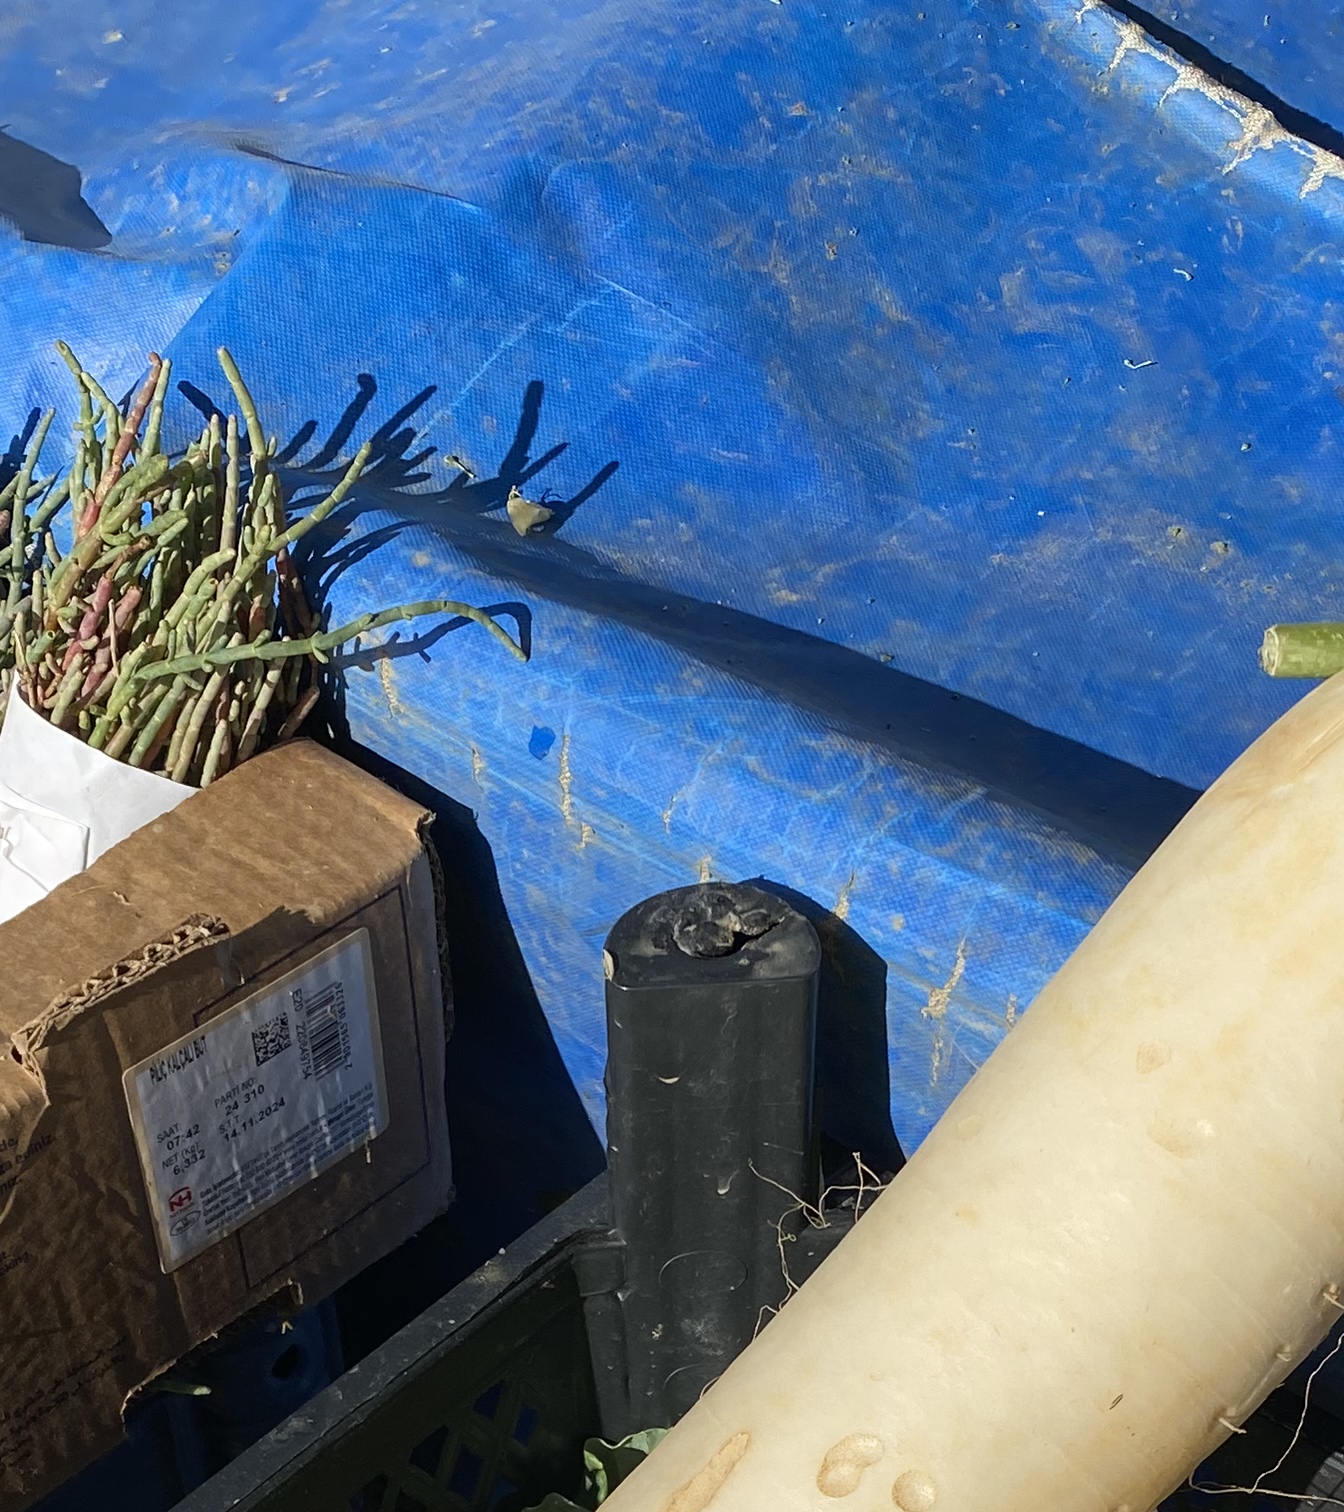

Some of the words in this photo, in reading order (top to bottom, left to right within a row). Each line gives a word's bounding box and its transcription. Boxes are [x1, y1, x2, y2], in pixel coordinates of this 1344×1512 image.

[292, 988, 304, 1012] E20
[193, 1034, 207, 1058] BUT
[225, 1100, 238, 1116] 24
[244, 1084, 265, 1104] 310
[224, 1096, 285, 1142] 14.11.2024
[166, 1123, 200, 1151] 07:42
[162, 1152, 178, 1170] NET
